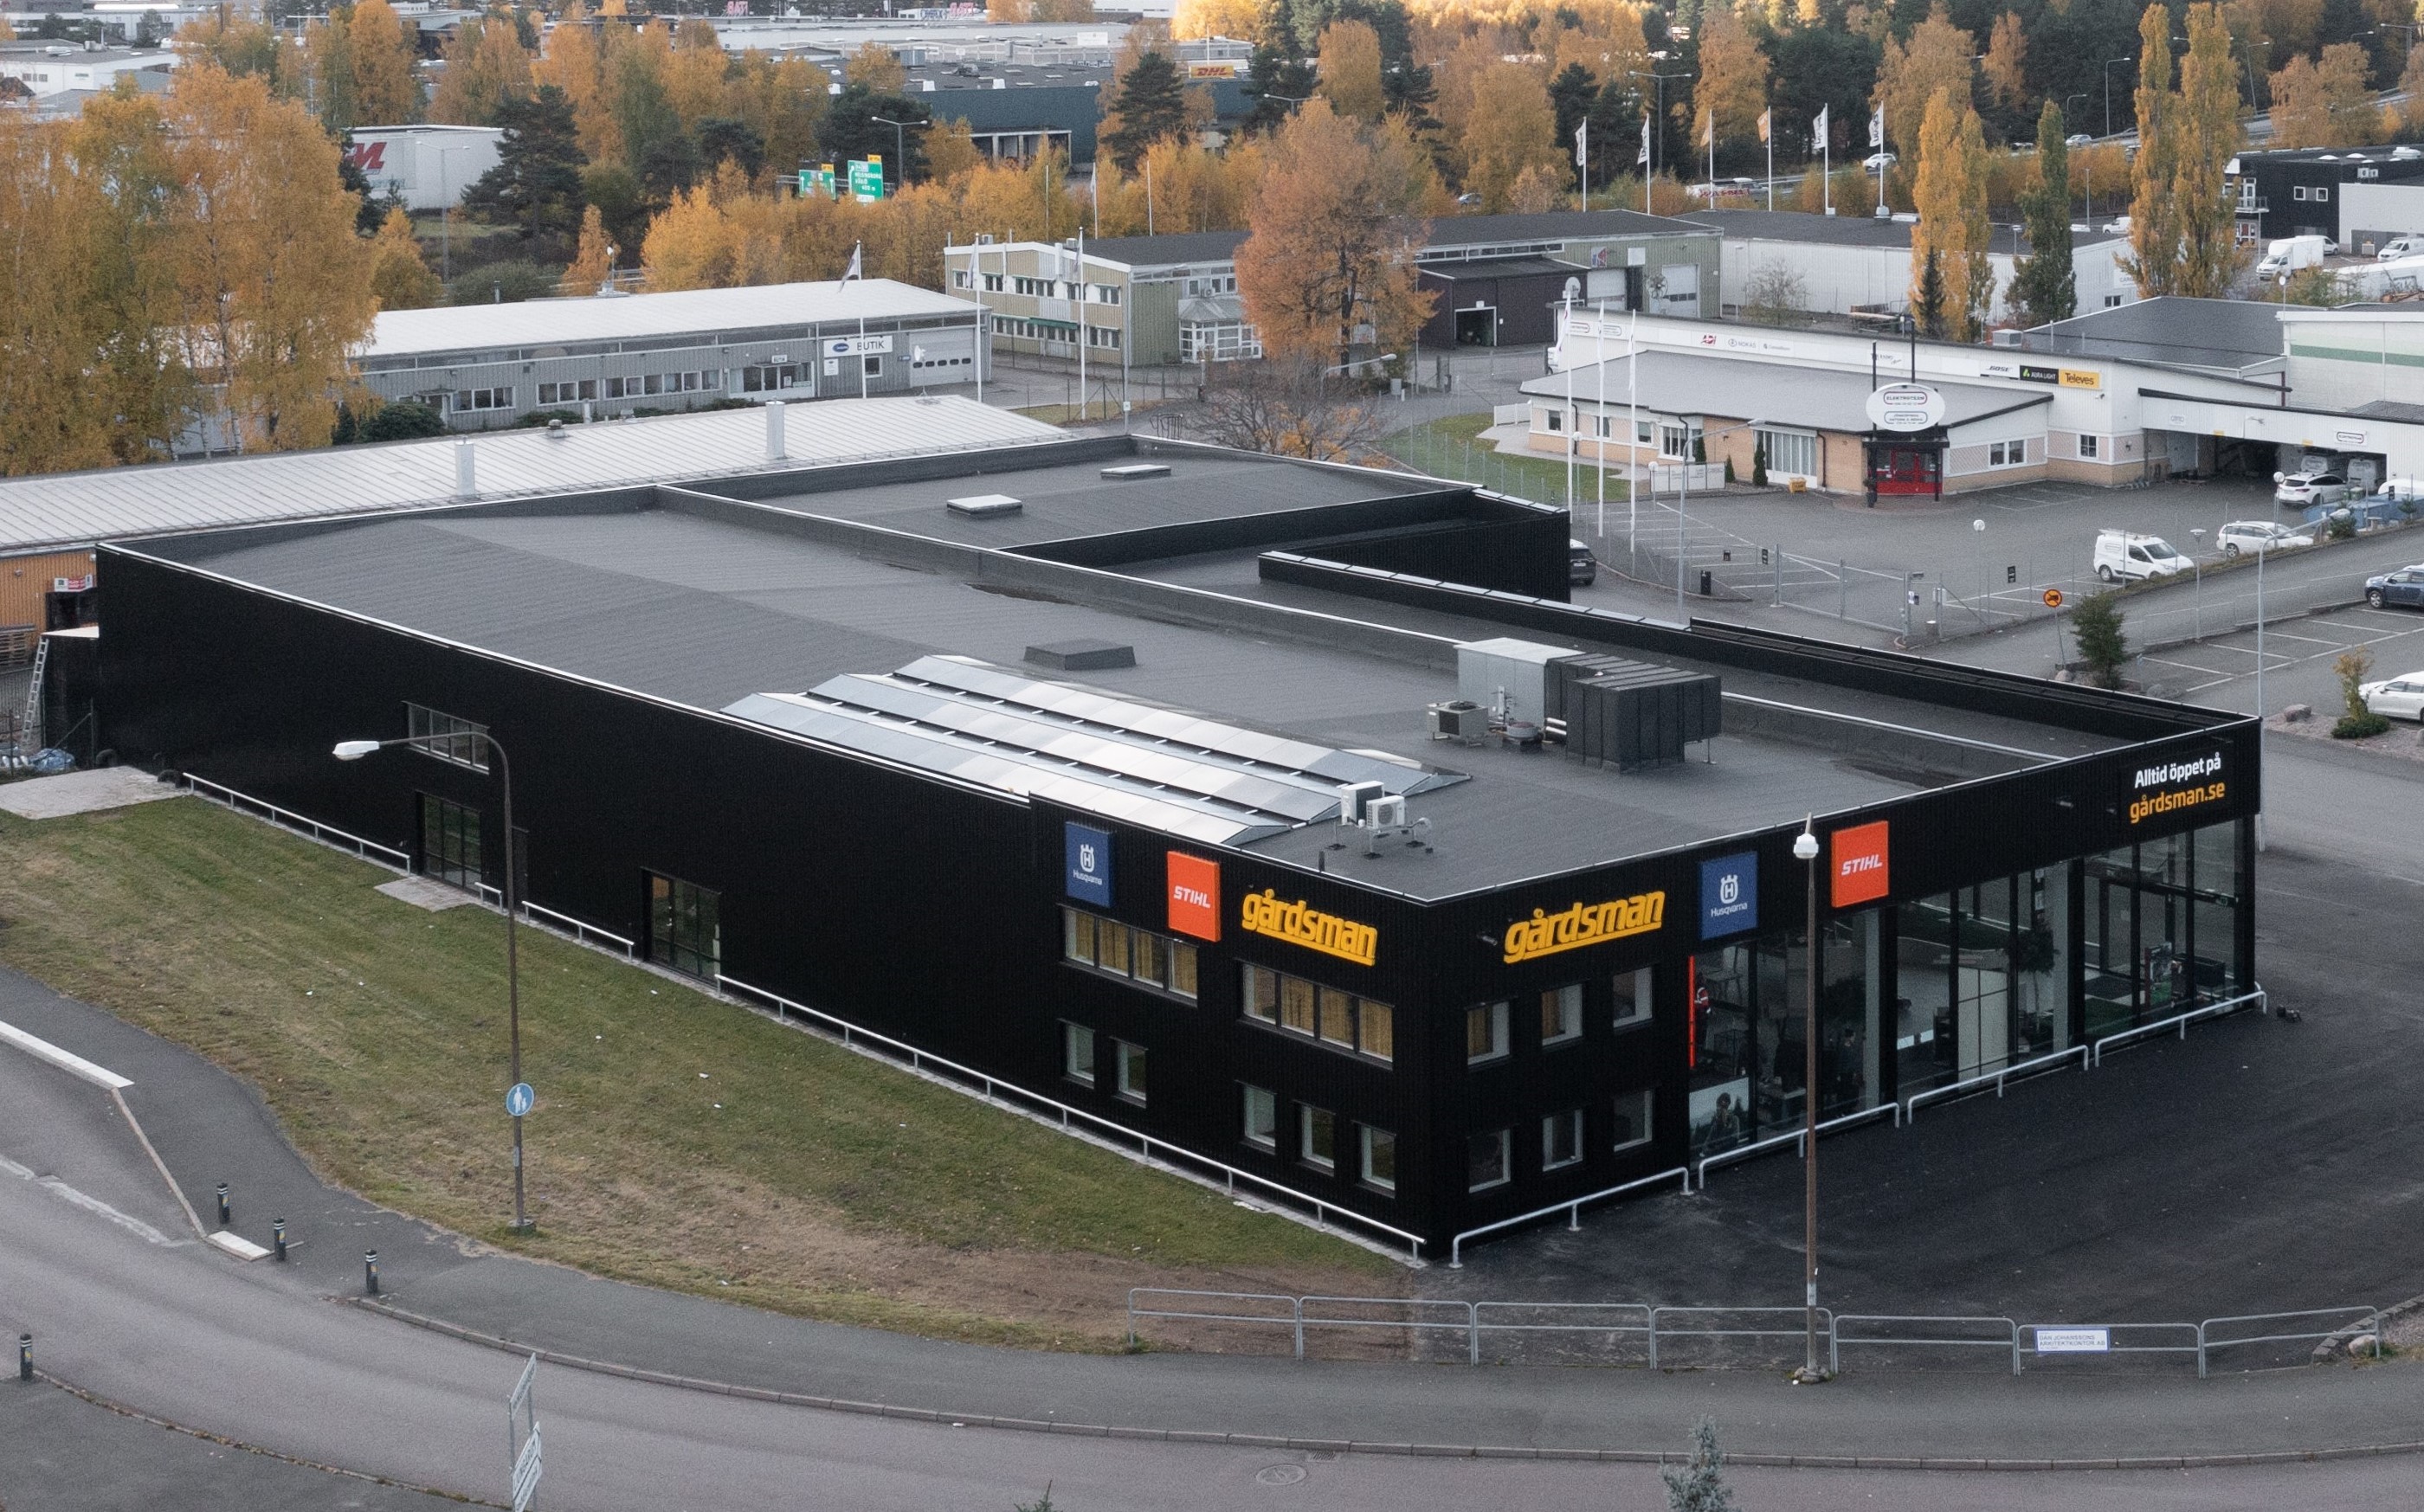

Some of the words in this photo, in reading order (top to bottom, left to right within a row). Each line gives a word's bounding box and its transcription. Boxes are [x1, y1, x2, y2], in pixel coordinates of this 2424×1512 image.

[1196, 67, 1228, 76] DHL
[856, 340, 885, 351] BUTIK
[2065, 372, 2094, 385] Televes
[2134, 765, 2167, 788] Alltid
[2169, 757, 2204, 782] öppet
[2206, 751, 2221, 775] på
[2130, 782, 2226, 823] gårdsman.se
[1841, 854, 1882, 876] STIHL
[1073, 869, 1103, 885] Husqvarna
[1173, 885, 1211, 908] STIHL
[1711, 901, 1748, 917] Husqvarna
[1241, 889, 1378, 965] gårdsman
[1504, 891, 1666, 964] gårdsman
